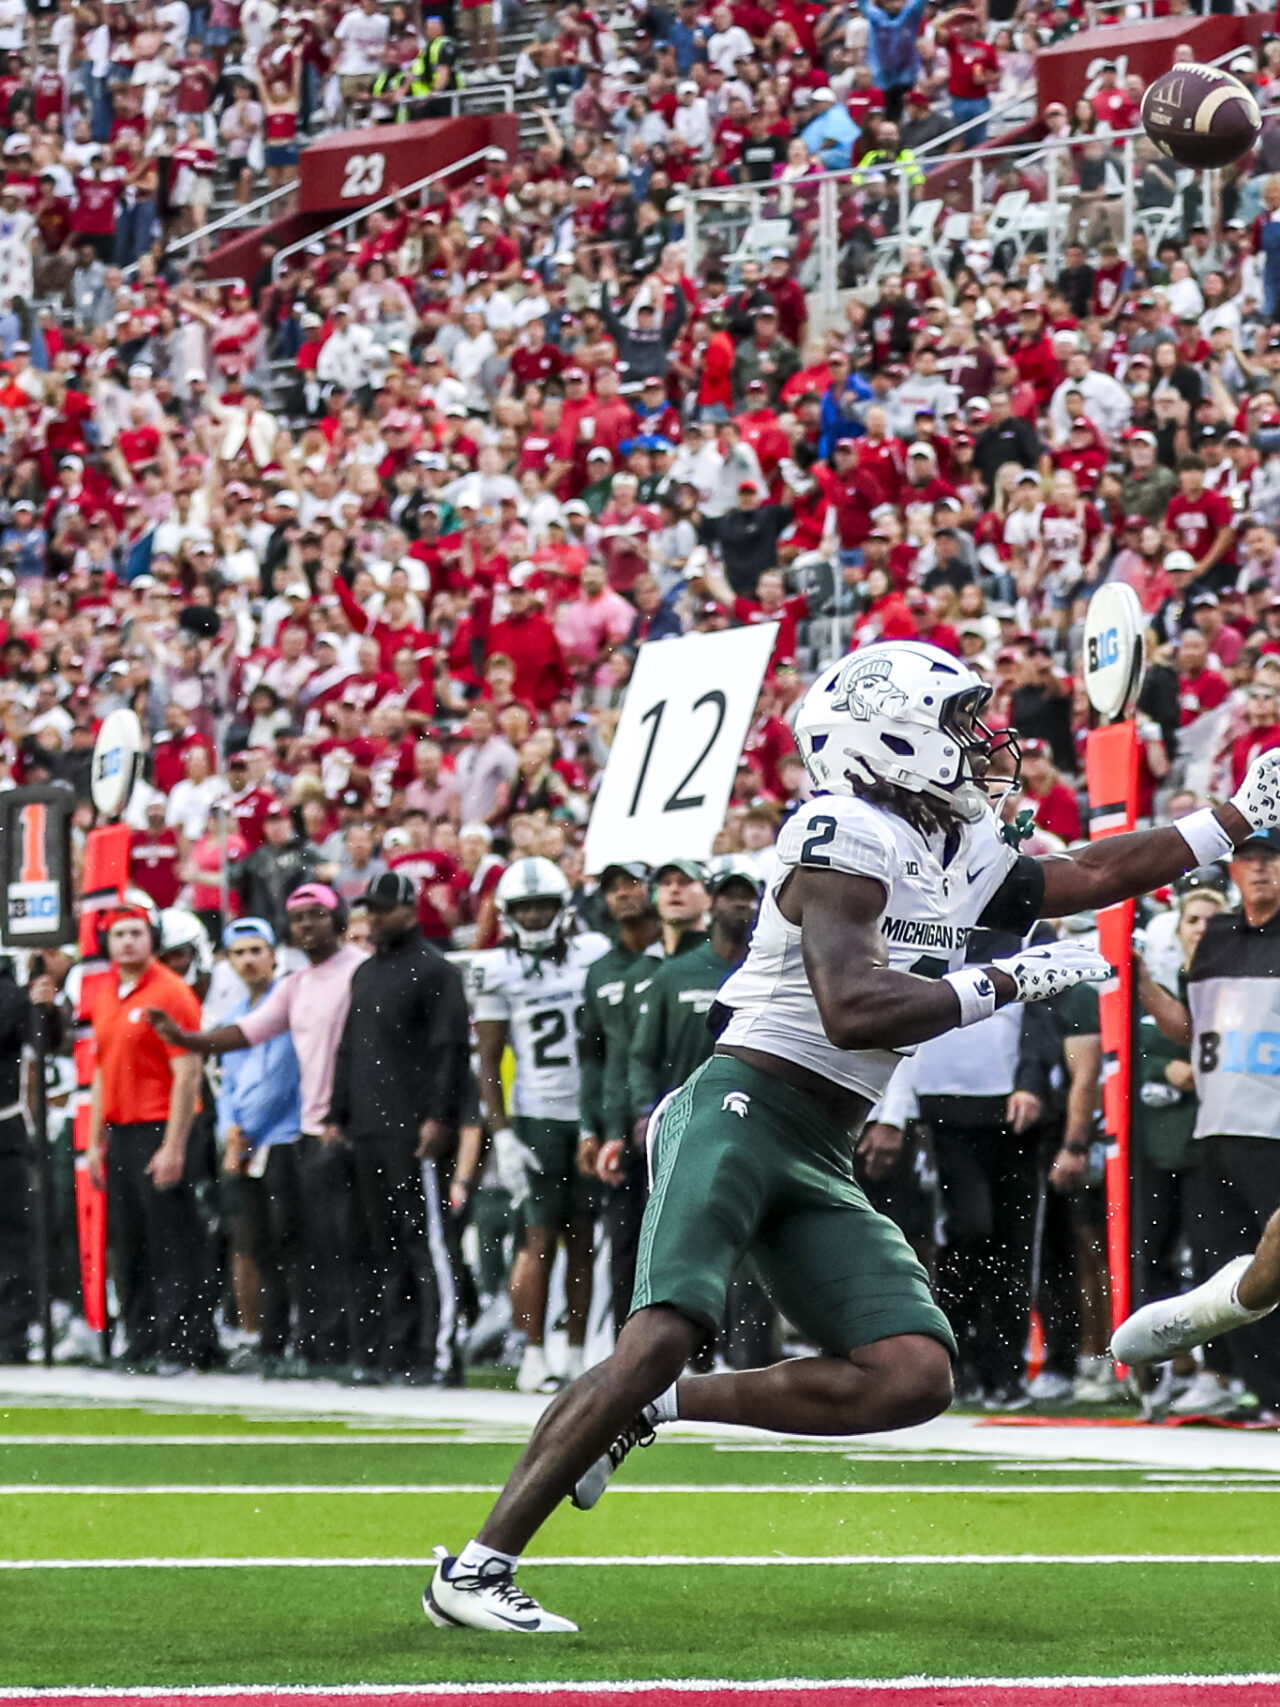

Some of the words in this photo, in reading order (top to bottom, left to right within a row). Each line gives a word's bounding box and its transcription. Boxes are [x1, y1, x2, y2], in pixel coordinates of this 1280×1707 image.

[340, 152, 386, 198] 23
[628, 689, 727, 818] 12
[19, 803, 49, 882] 1
[801, 815, 836, 866] 2
[880, 916, 953, 949] MICHIGAN
